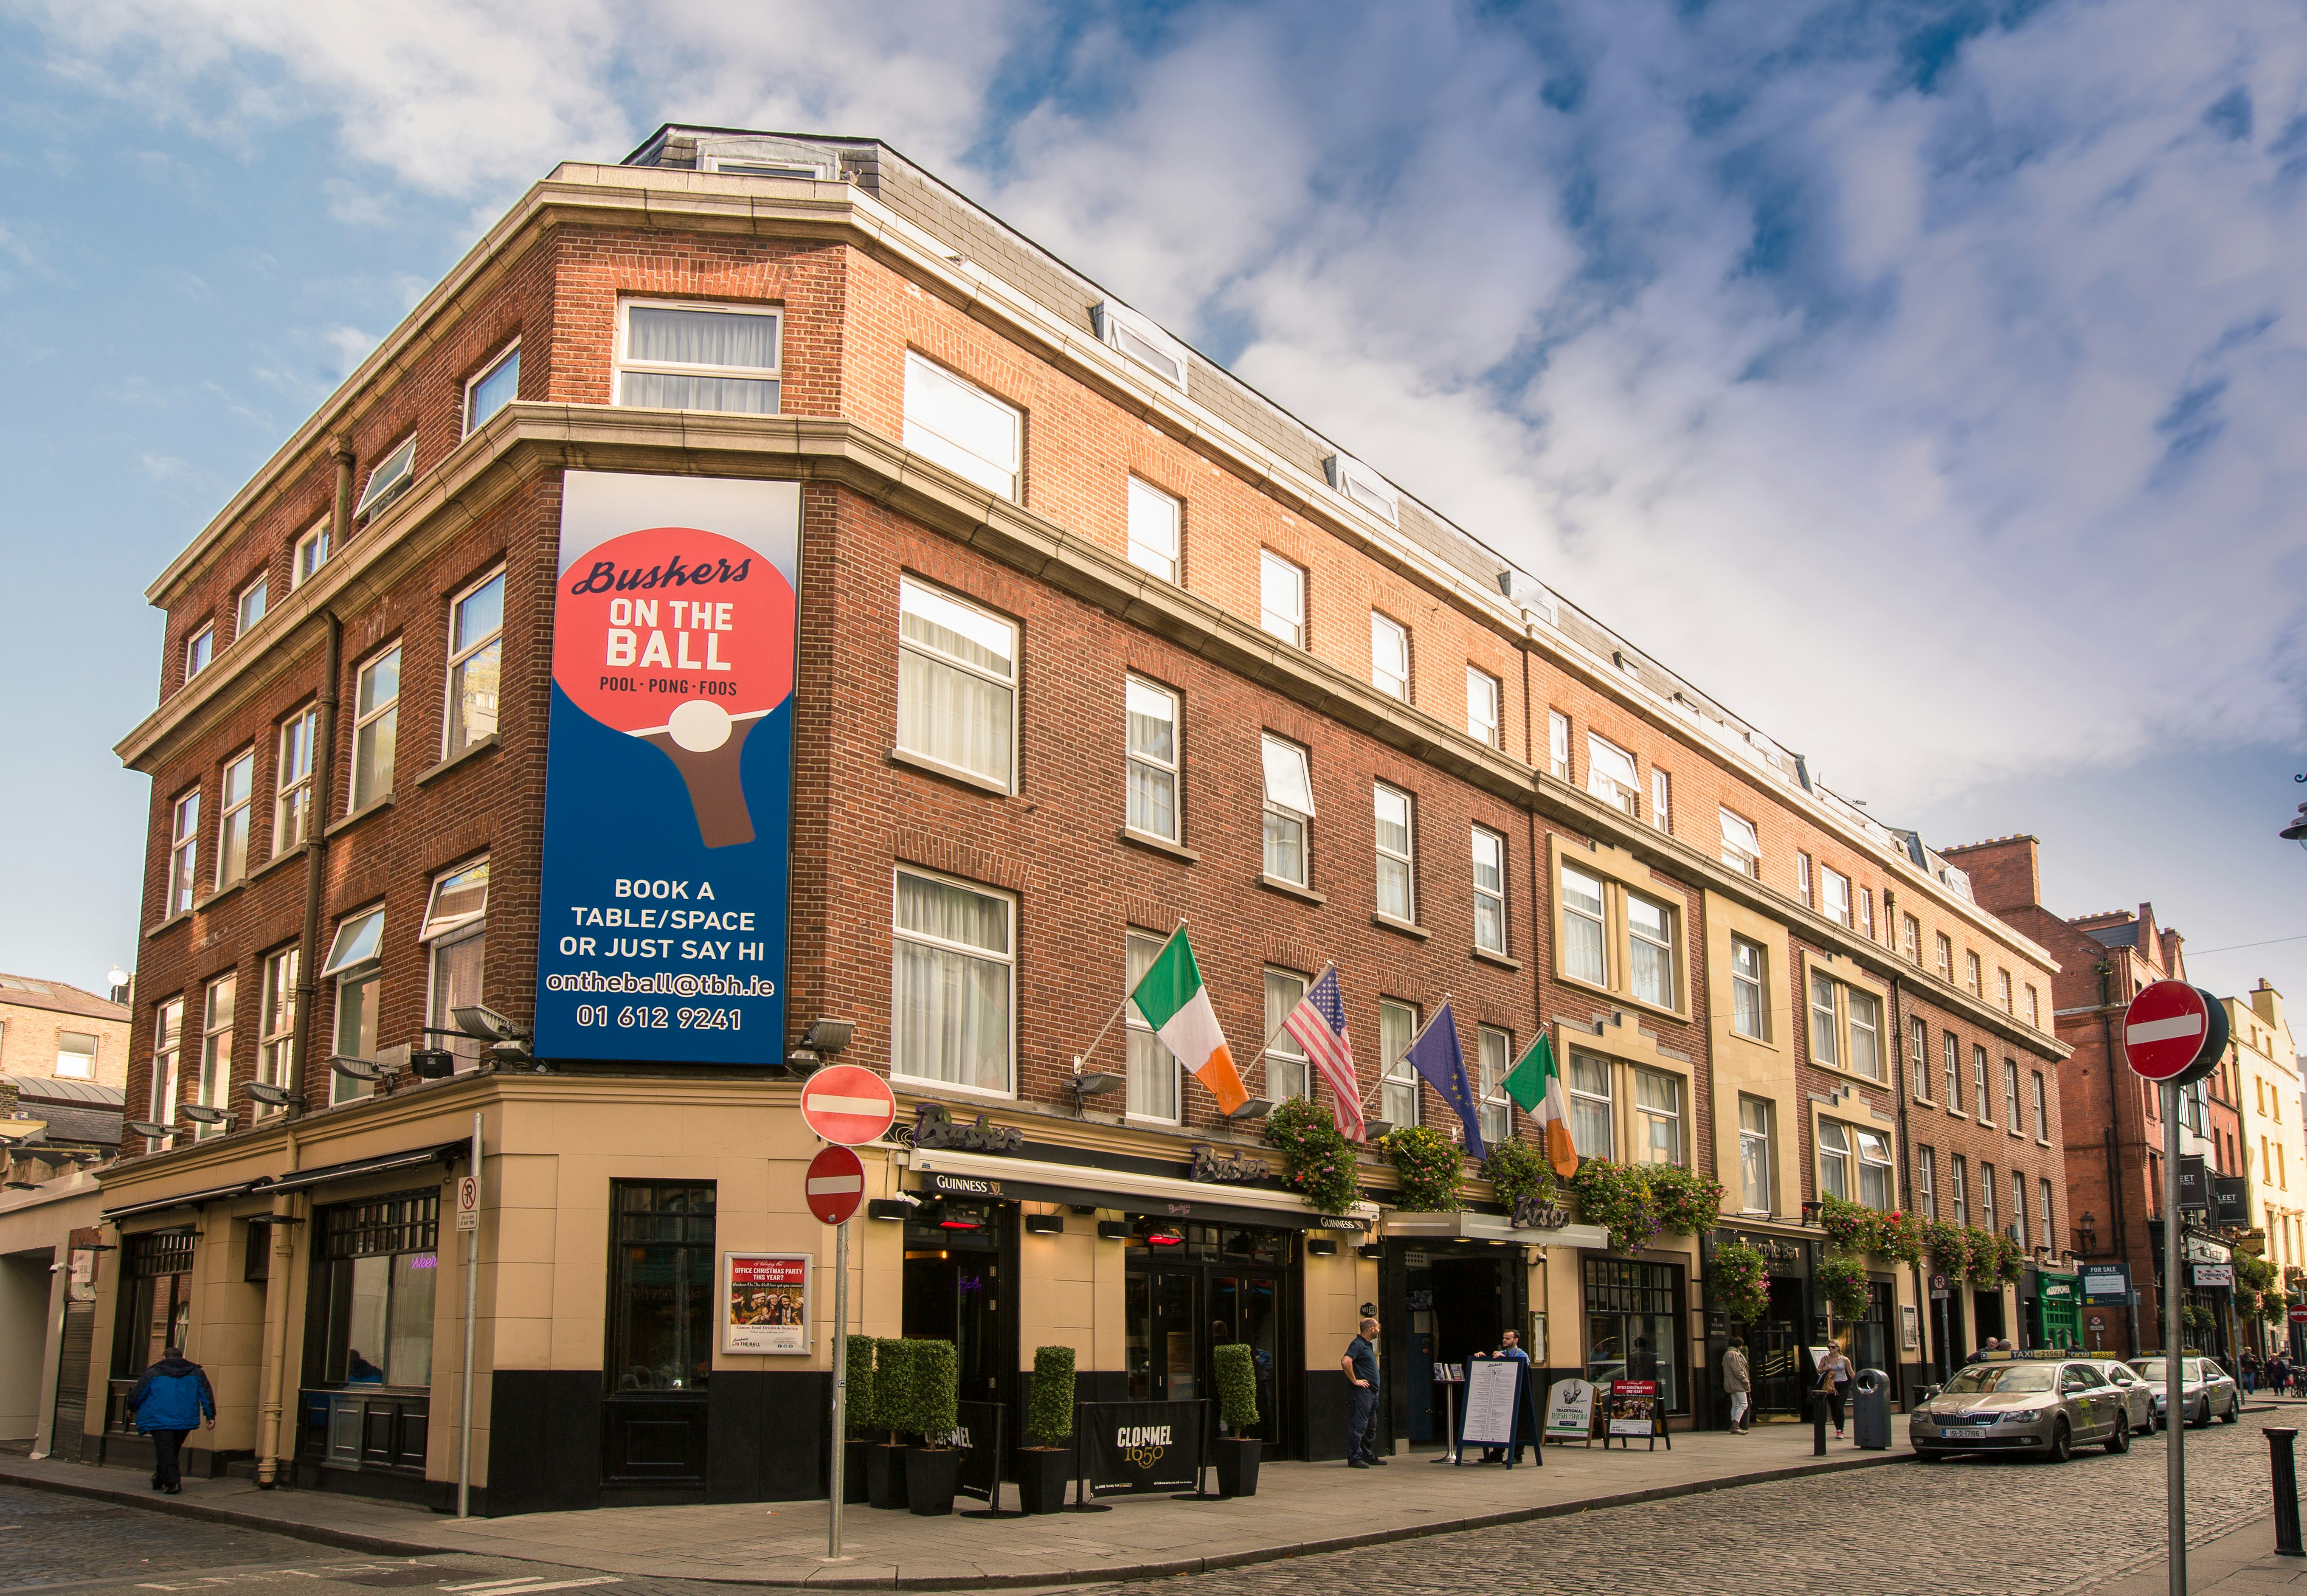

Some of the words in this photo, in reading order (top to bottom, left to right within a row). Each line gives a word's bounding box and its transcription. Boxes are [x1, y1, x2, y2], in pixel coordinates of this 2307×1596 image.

[571, 555, 751, 595] Buskers
[610, 598, 658, 627] ON
[669, 601, 734, 631] THE
[606, 628, 731, 671] BALL
[600, 676, 637, 692] POOL
[649, 678, 688, 694] PONG
[700, 680, 737, 696] FOOS
[615, 878, 689, 900] BOOK
[696, 881, 715, 901] A
[571, 906, 755, 931] TABLE/SPACE
[560, 936, 596, 956] OR
[604, 938, 674, 958] JUST
[681, 940, 731, 960] SAY
[738, 942, 764, 961] HI
[546, 970, 774, 997] ontheball@tbh.ie
[577, 1004, 608, 1027] 01
[617, 1006, 669, 1028] 612
[677, 1007, 741, 1030] 9241
[937, 1175, 988, 1193] GUINNESS
[1321, 1217, 1354, 1228] GUINNESS
[1117, 1426, 1172, 1447] CLONMEL
[1124, 1446, 1164, 1465] 1650
